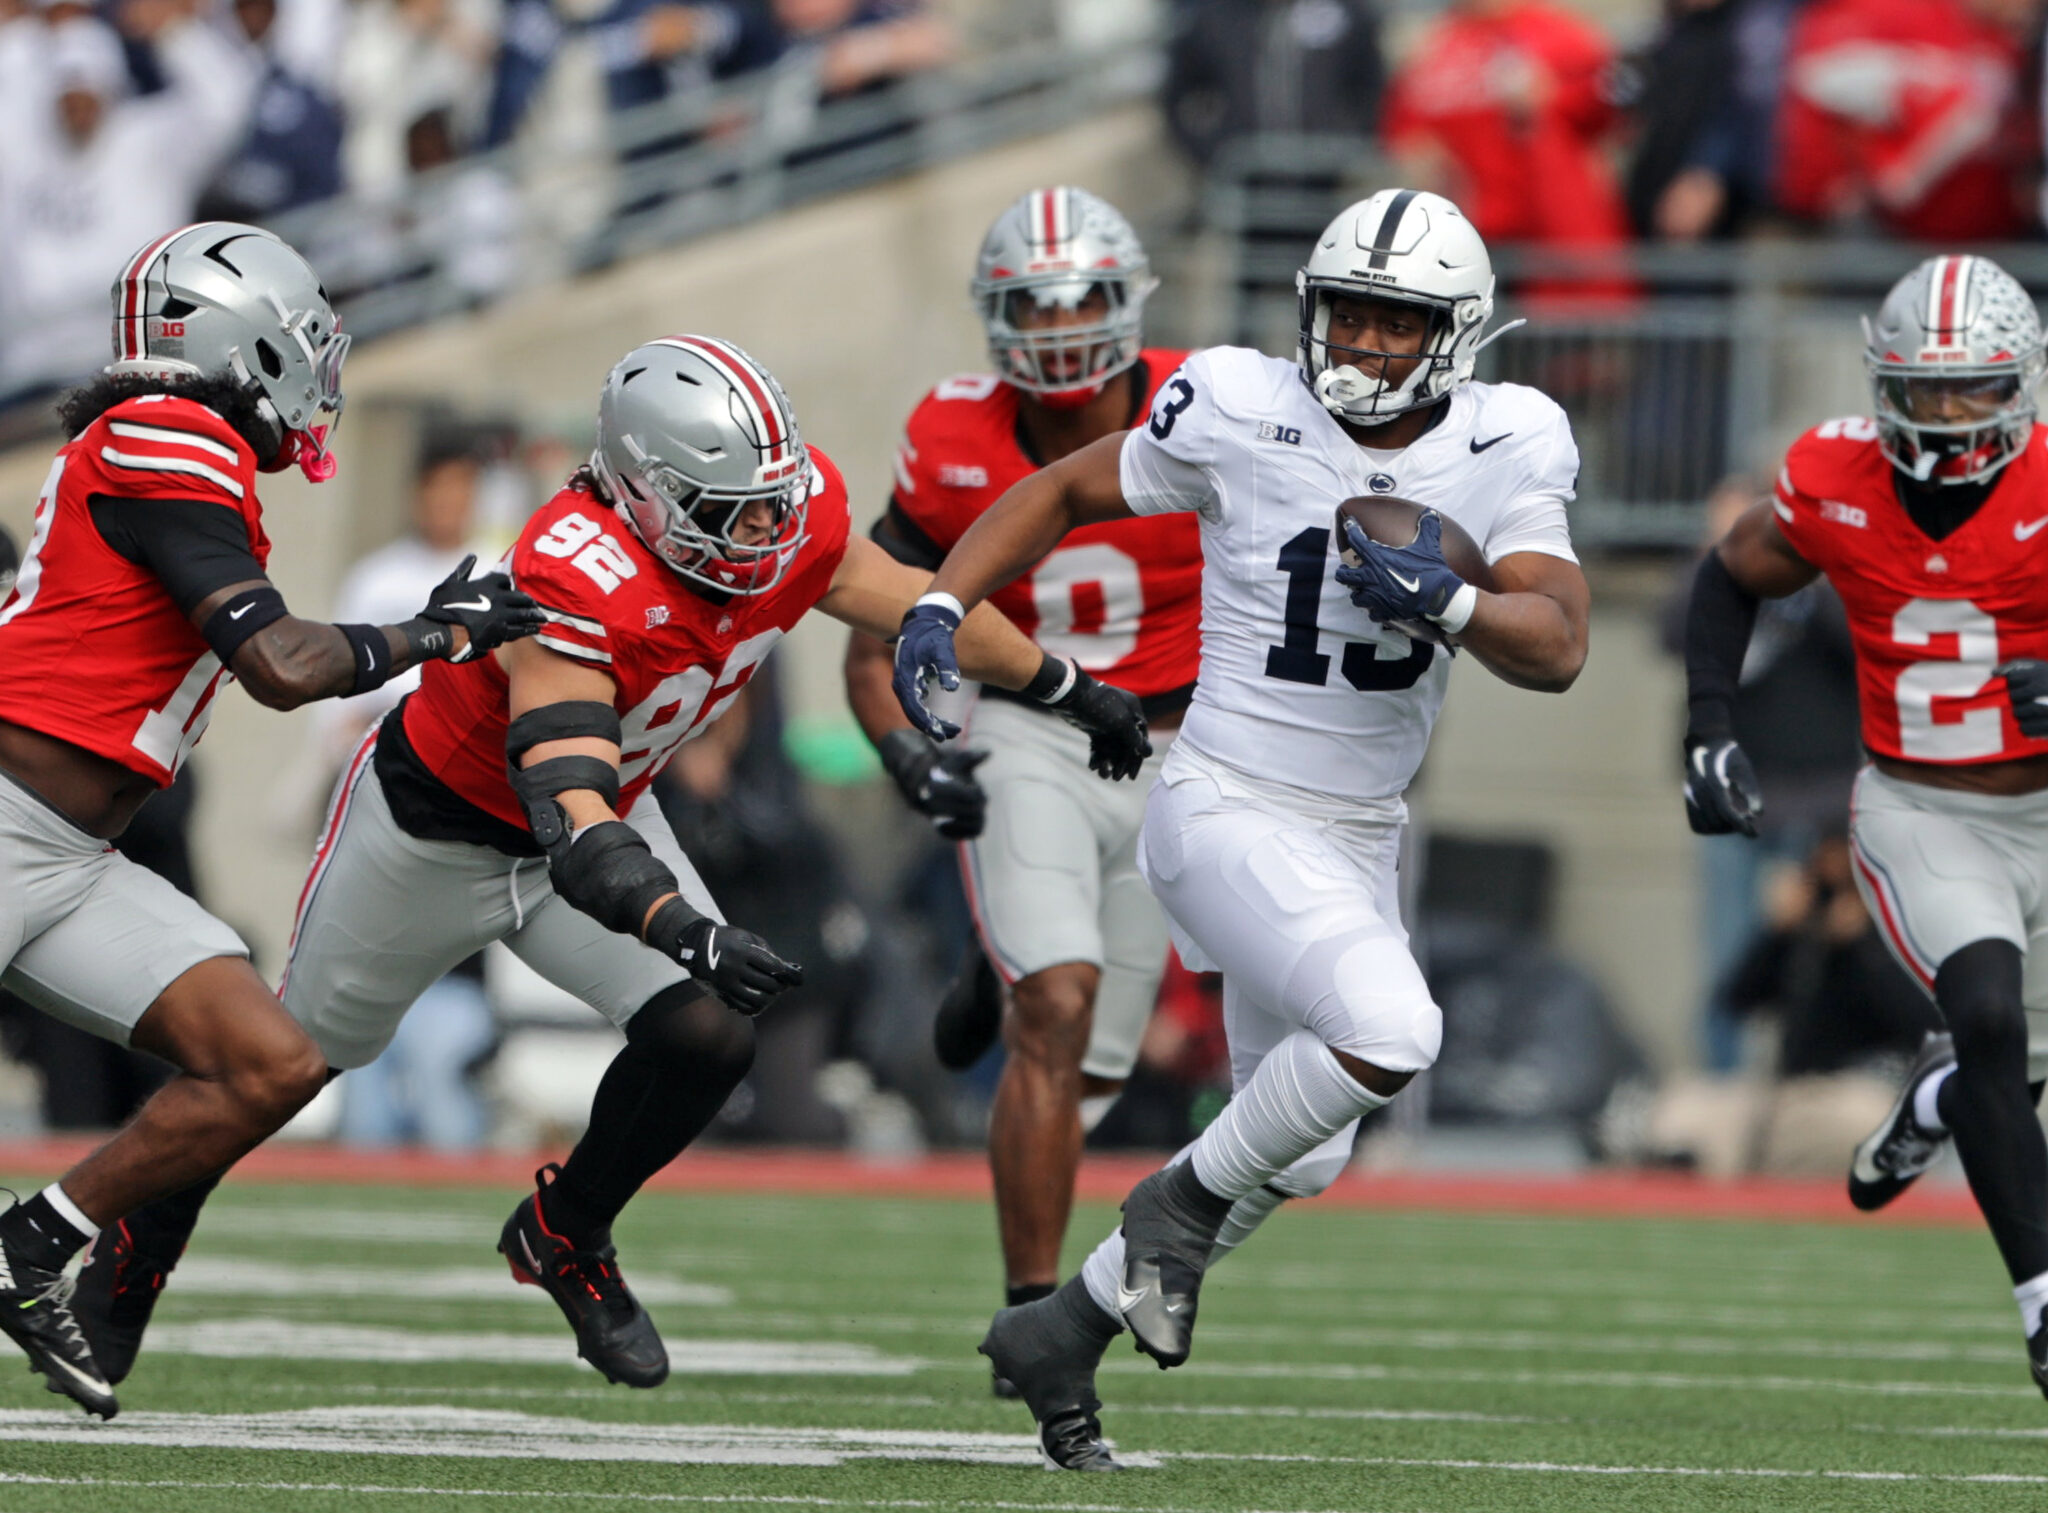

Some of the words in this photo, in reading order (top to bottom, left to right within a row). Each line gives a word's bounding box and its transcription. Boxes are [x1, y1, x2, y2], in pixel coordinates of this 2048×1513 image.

[1372, 272, 1397, 284] STATE
[1146, 368, 1194, 441] 3
[533, 512, 638, 596] 92
[1032, 541, 1144, 670] 0
[1892, 597, 2004, 761] 2
